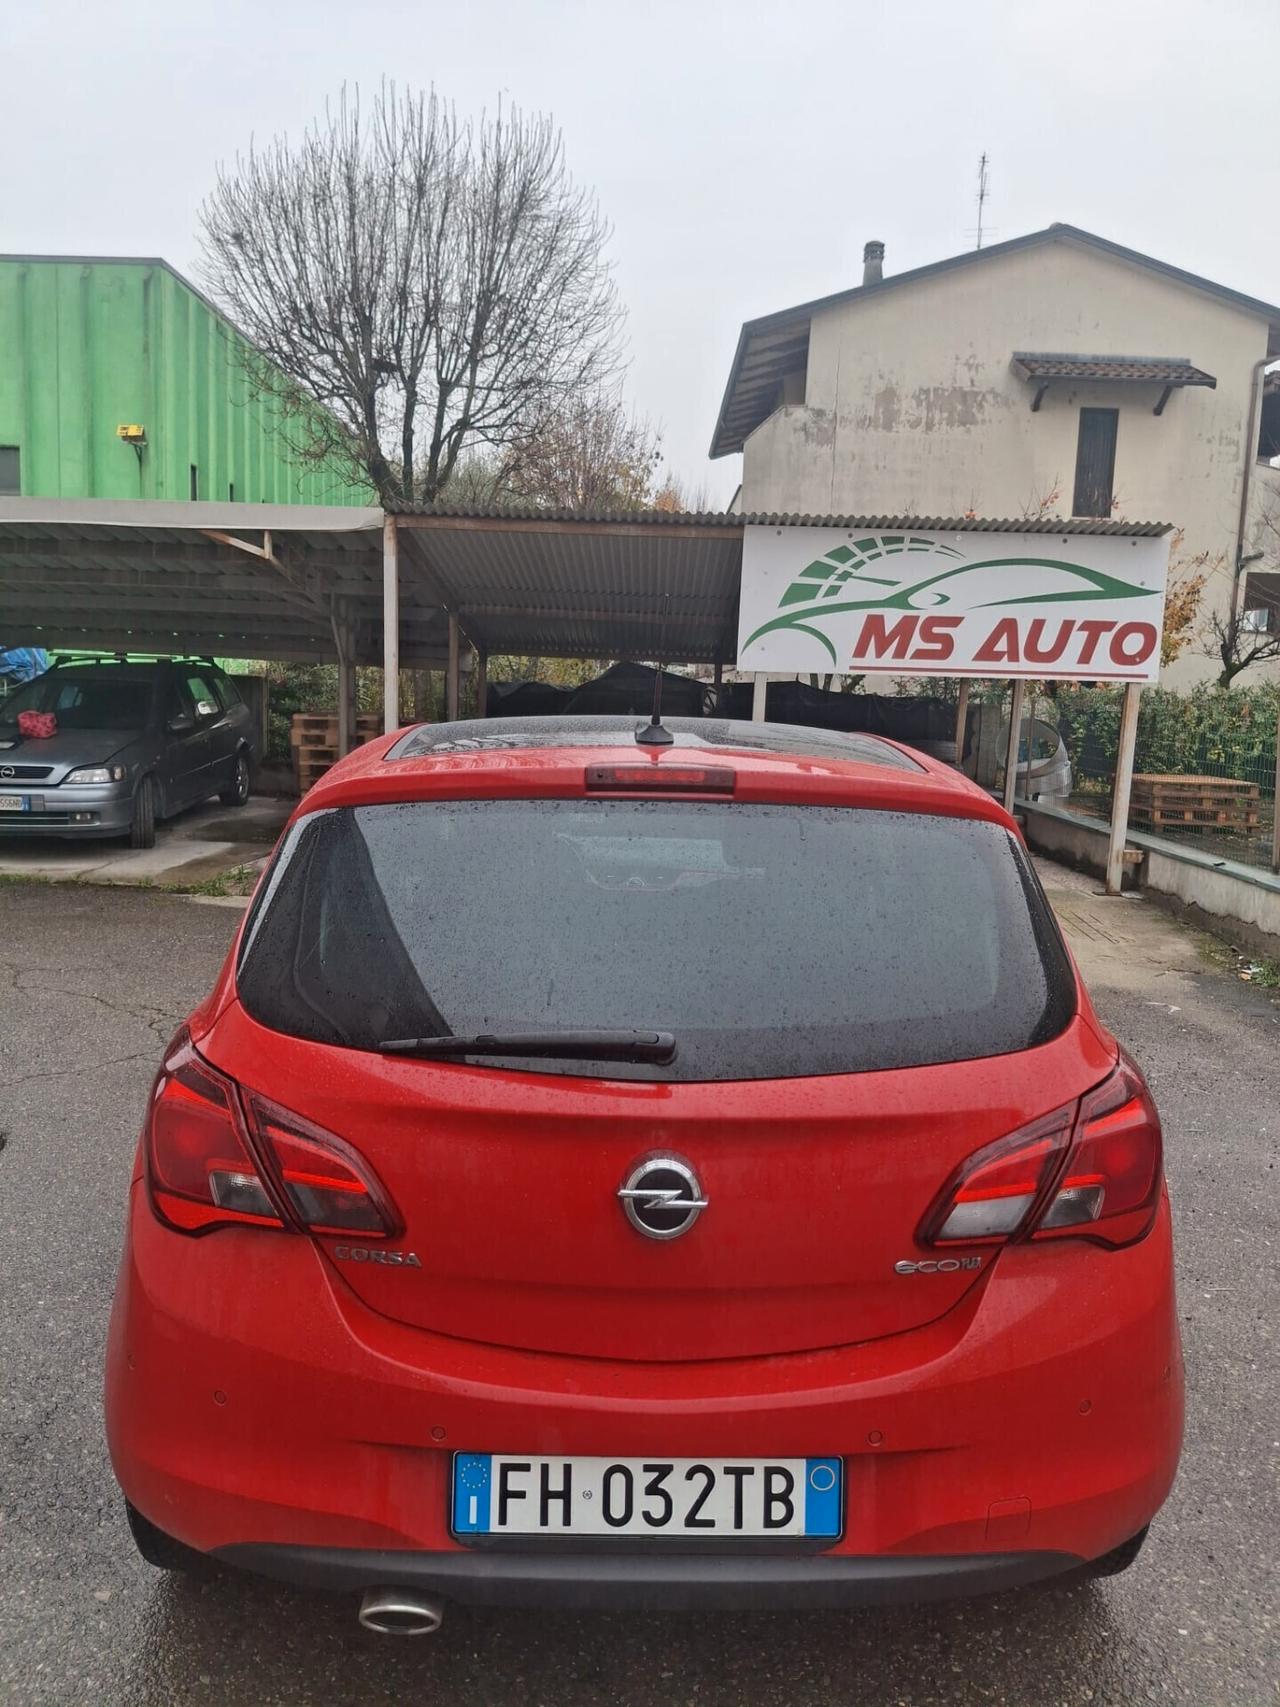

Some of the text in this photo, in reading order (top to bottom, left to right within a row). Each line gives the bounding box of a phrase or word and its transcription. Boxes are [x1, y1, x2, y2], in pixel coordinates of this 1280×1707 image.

[852, 614, 1158, 667] MS AUTO
[335, 1246, 422, 1267] CORSA
[497, 1462, 572, 1527] FH
[602, 1463, 795, 1530] 032TB
